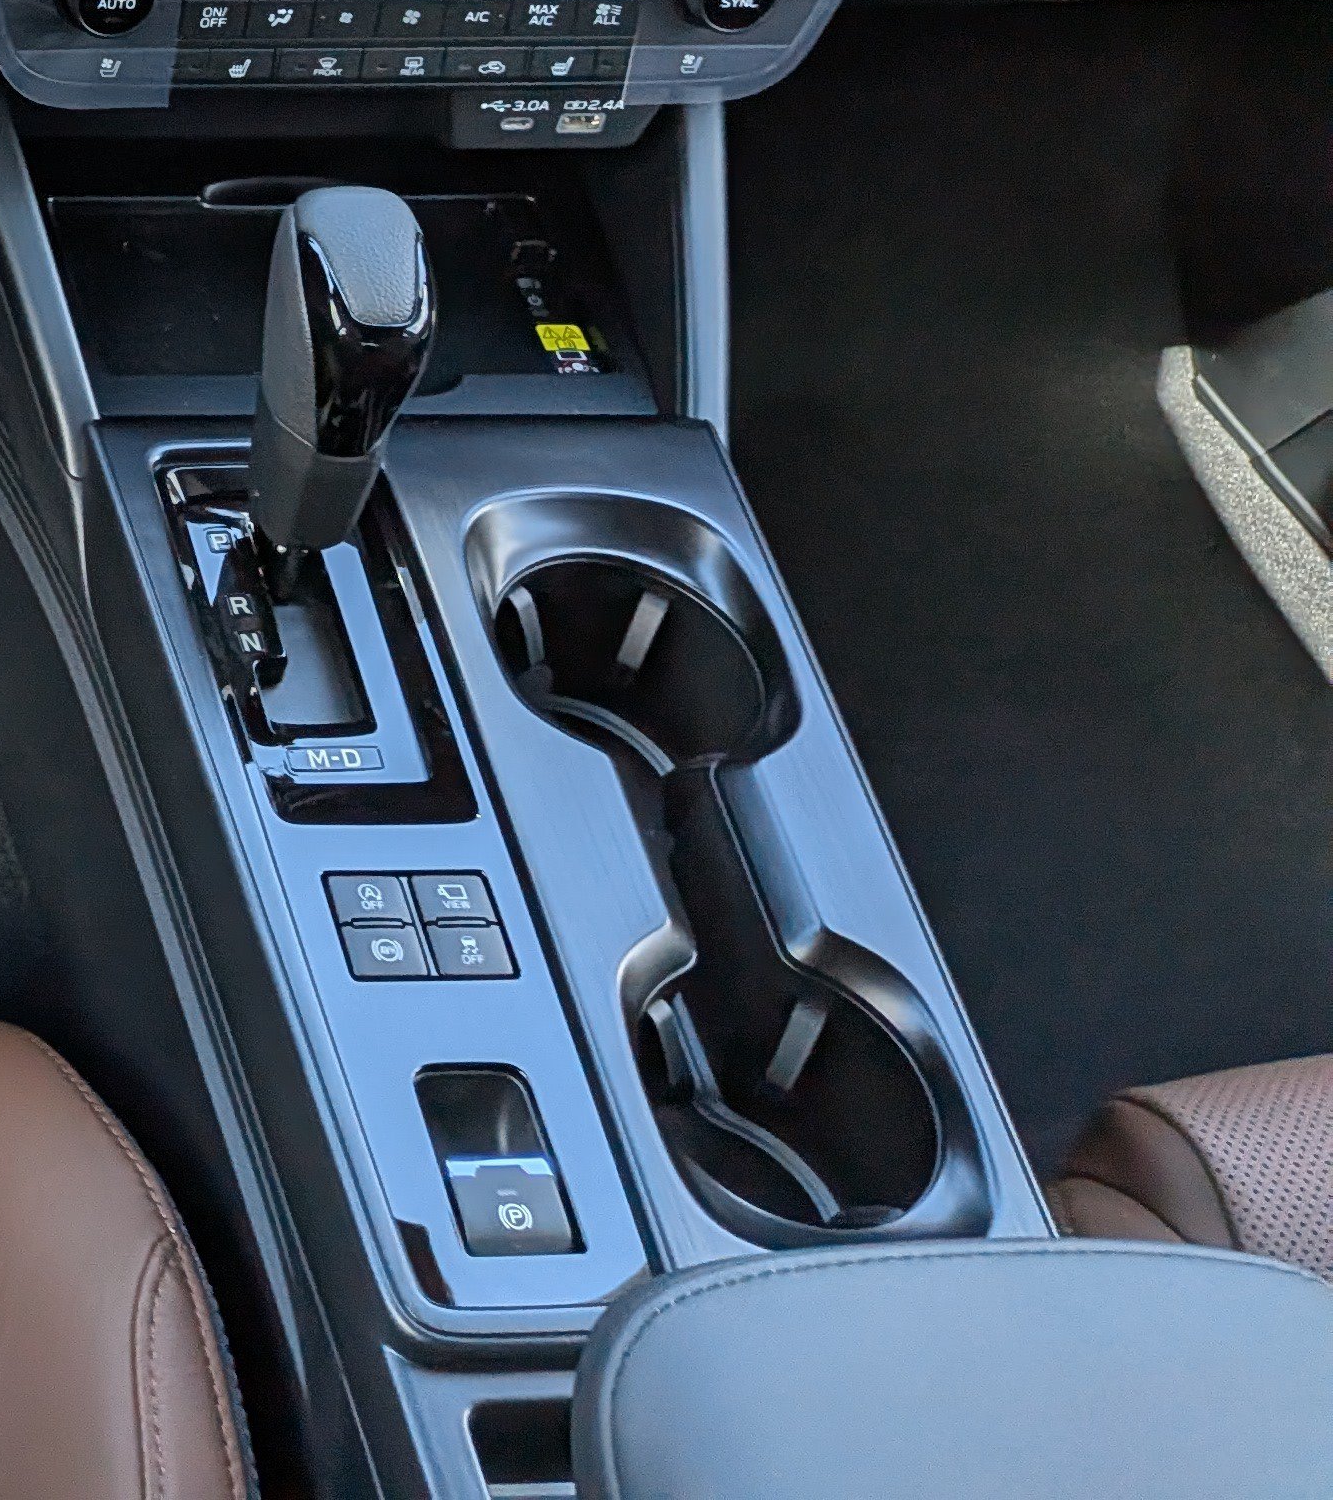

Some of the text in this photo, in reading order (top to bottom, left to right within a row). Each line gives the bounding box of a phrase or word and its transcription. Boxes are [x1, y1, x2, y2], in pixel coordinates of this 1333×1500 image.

[96, 0, 136, 10] AUTO
[528, 4, 559, 14] MAX
[464, 11, 490, 23] A/C
[528, 15, 554, 26] A/C
[593, 15, 620, 26] ALL
[199, 17, 228, 29] OFF
[313, 68, 343, 76] FRONT
[512, 101, 550, 111] 3.0A
[586, 100, 624, 111] 2.4A
[229, 596, 253, 615] R
[239, 632, 263, 652] N
[307, 748, 361, 769] M-D
[361, 900, 384, 910] OFF
[442, 900, 470, 909] VIEW
[461, 954, 484, 965] OFF
